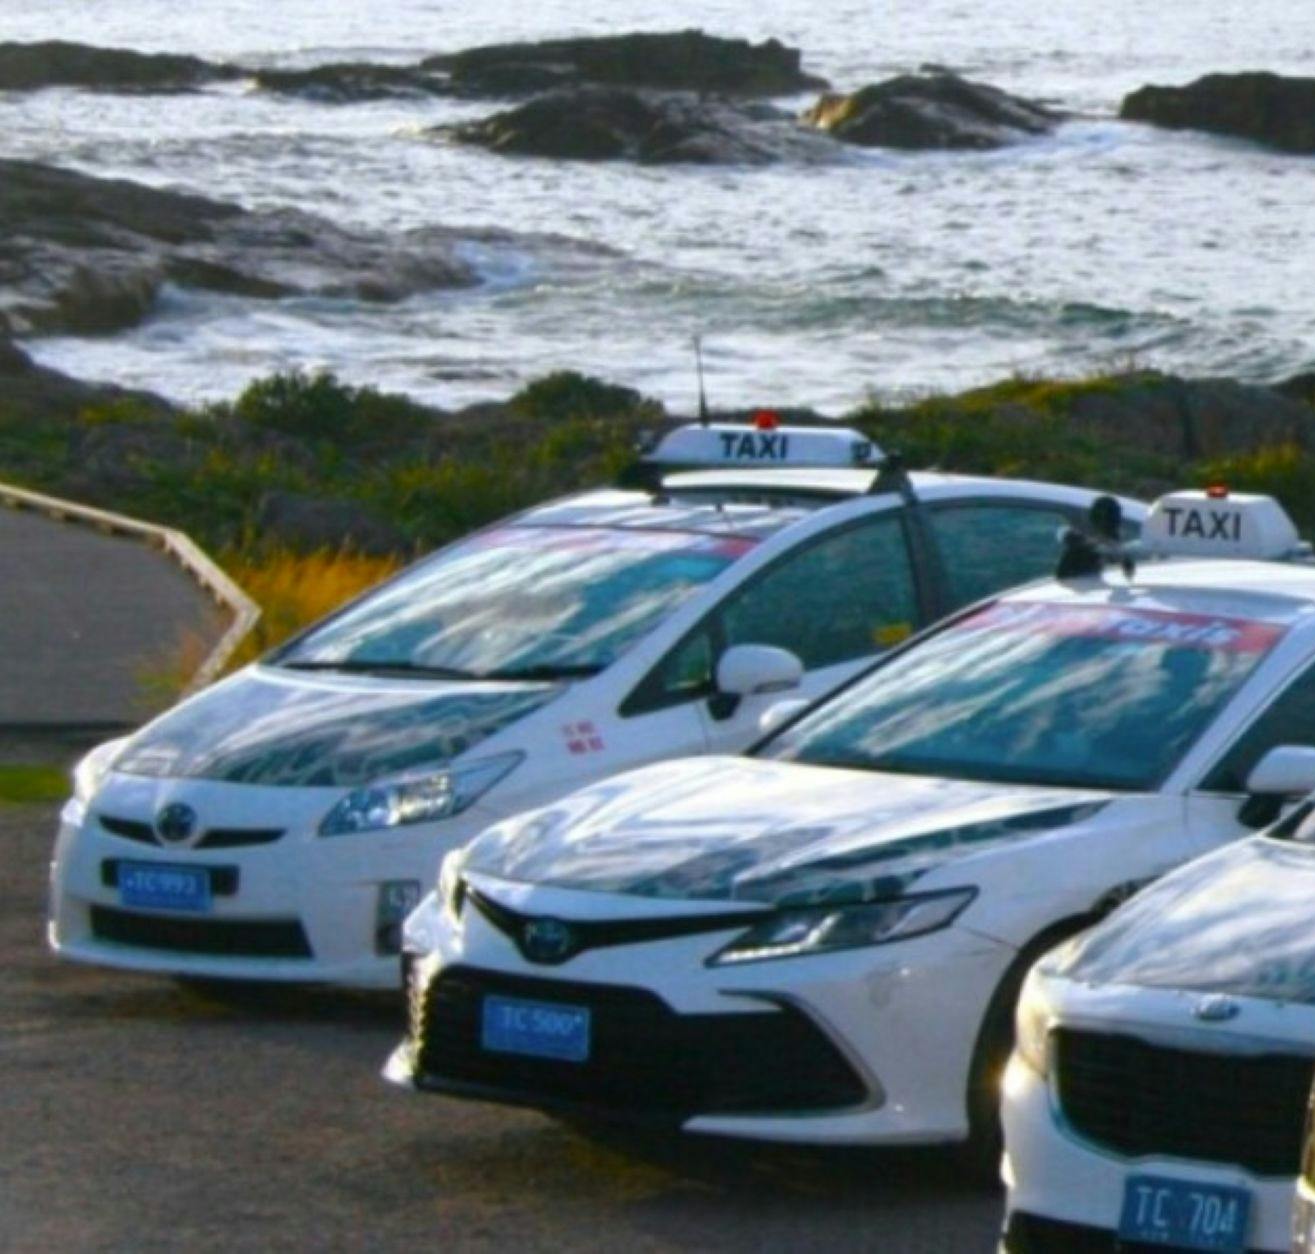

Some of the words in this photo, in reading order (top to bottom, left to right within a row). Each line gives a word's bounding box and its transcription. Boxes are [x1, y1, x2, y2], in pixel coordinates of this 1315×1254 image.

[719, 432, 789, 460] TAXI
[1163, 507, 1242, 541] TAXI
[502, 1006, 528, 1032] TC
[1136, 1186, 1171, 1227] TC
[1189, 1192, 1238, 1236] 704
